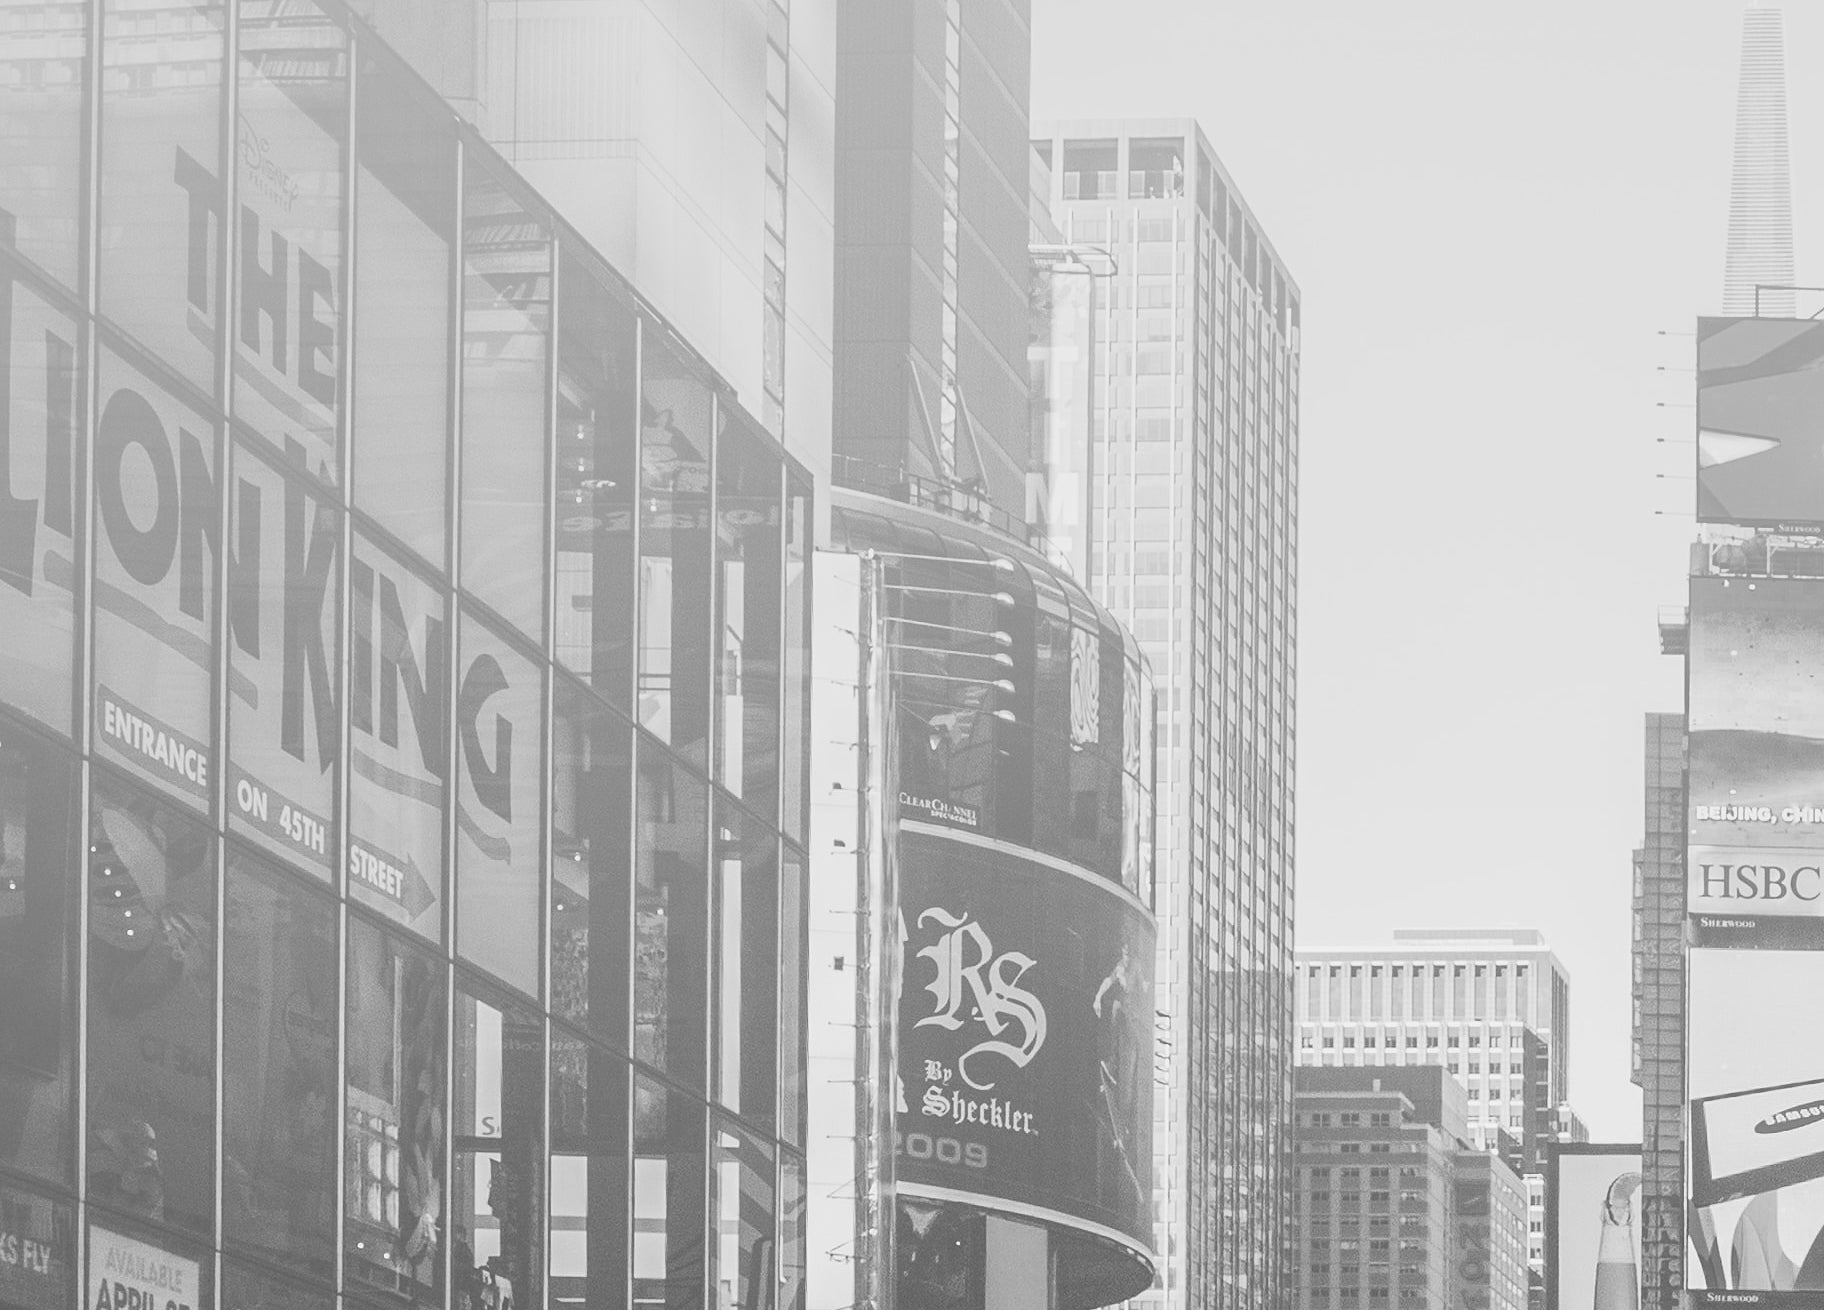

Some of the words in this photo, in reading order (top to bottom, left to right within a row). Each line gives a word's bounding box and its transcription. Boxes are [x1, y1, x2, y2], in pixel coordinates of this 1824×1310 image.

[174, 143, 337, 412] THE
[281, 433, 513, 824] KING
[103, 701, 208, 788] ENTRANCE
[236, 778, 269, 821] ON
[279, 804, 325, 855] 45TH
[349, 844, 404, 899] STREET
[1696, 804, 1778, 824] BEIJING,
[1699, 863, 1822, 901] HSBC
[923, 1059, 953, 1087] By
[105, 1247, 183, 1294] AVAILABLE
